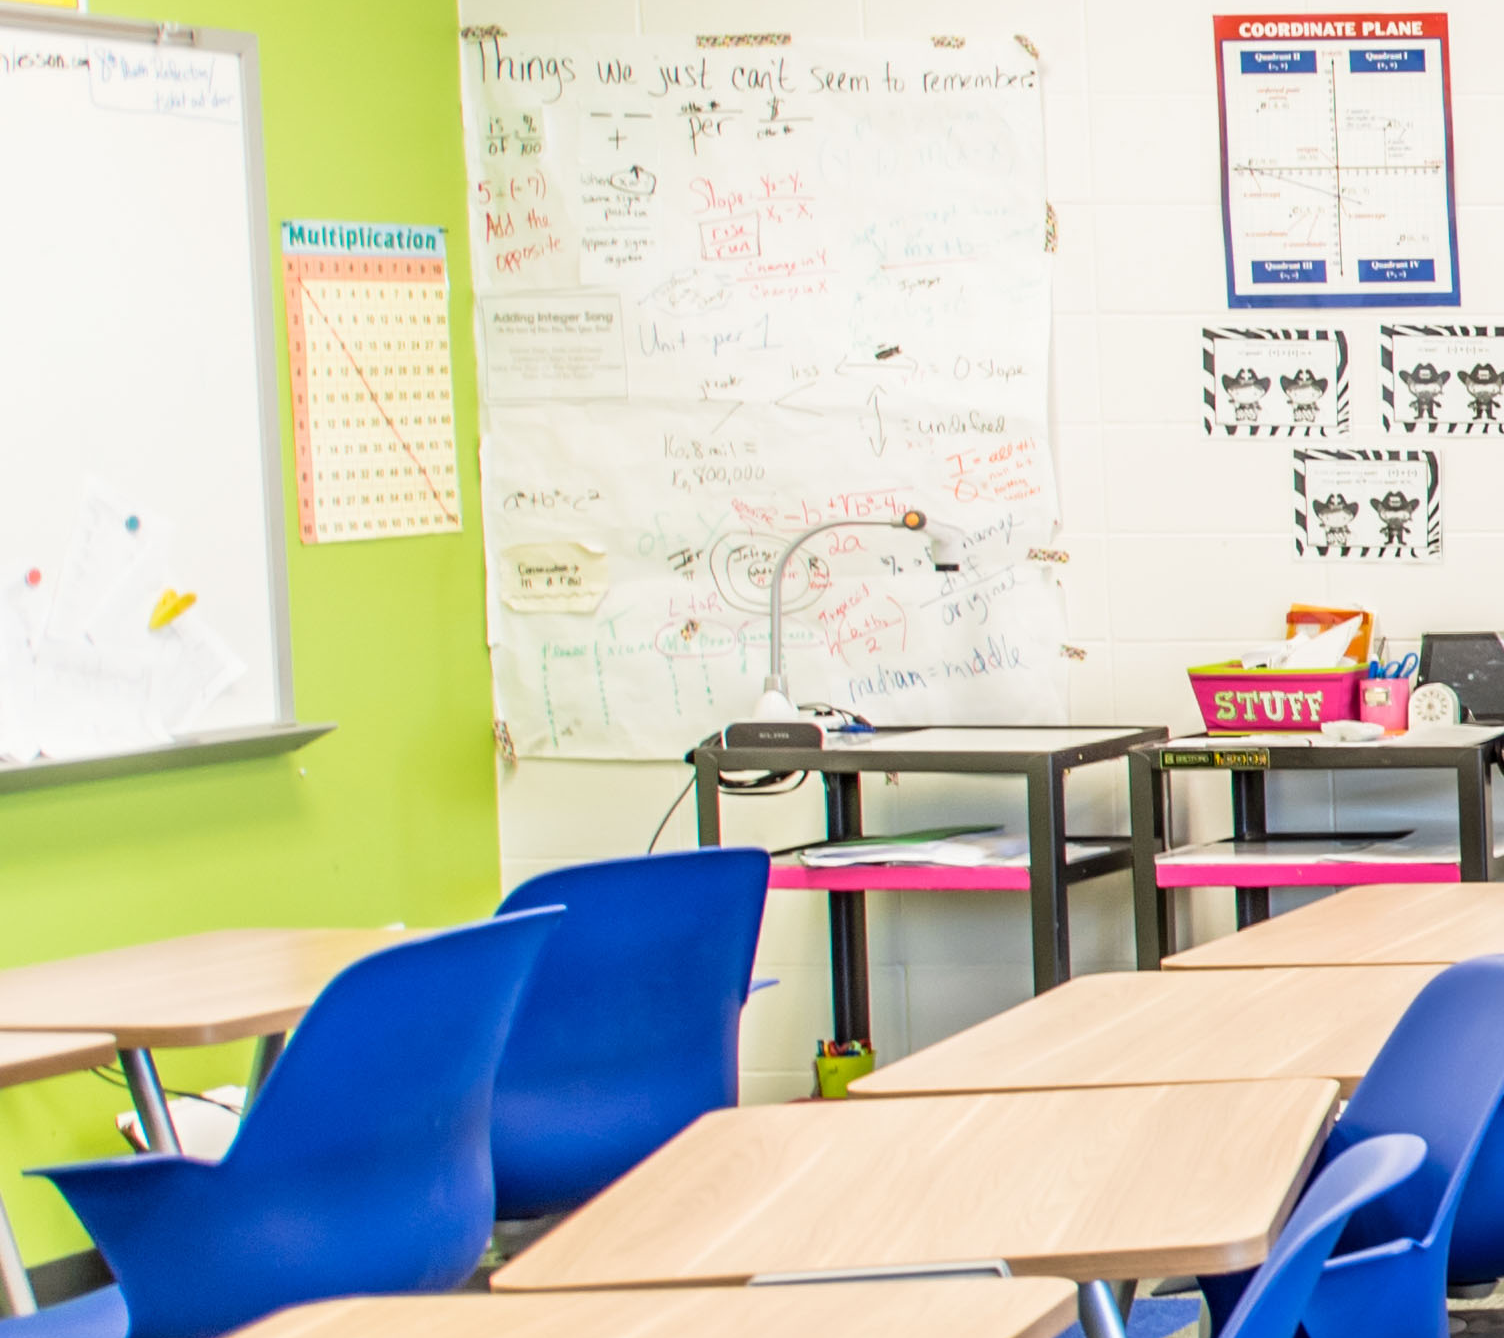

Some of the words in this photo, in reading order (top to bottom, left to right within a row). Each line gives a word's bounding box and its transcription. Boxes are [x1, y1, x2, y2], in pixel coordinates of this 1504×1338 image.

[1239, 22, 1356, 37] COORDINATE
[1363, 21, 1423, 36] PLANE
[478, 36, 576, 103] Things
[289, 226, 437, 251] Multiplication
[1214, 690, 1323, 722] STUFF
